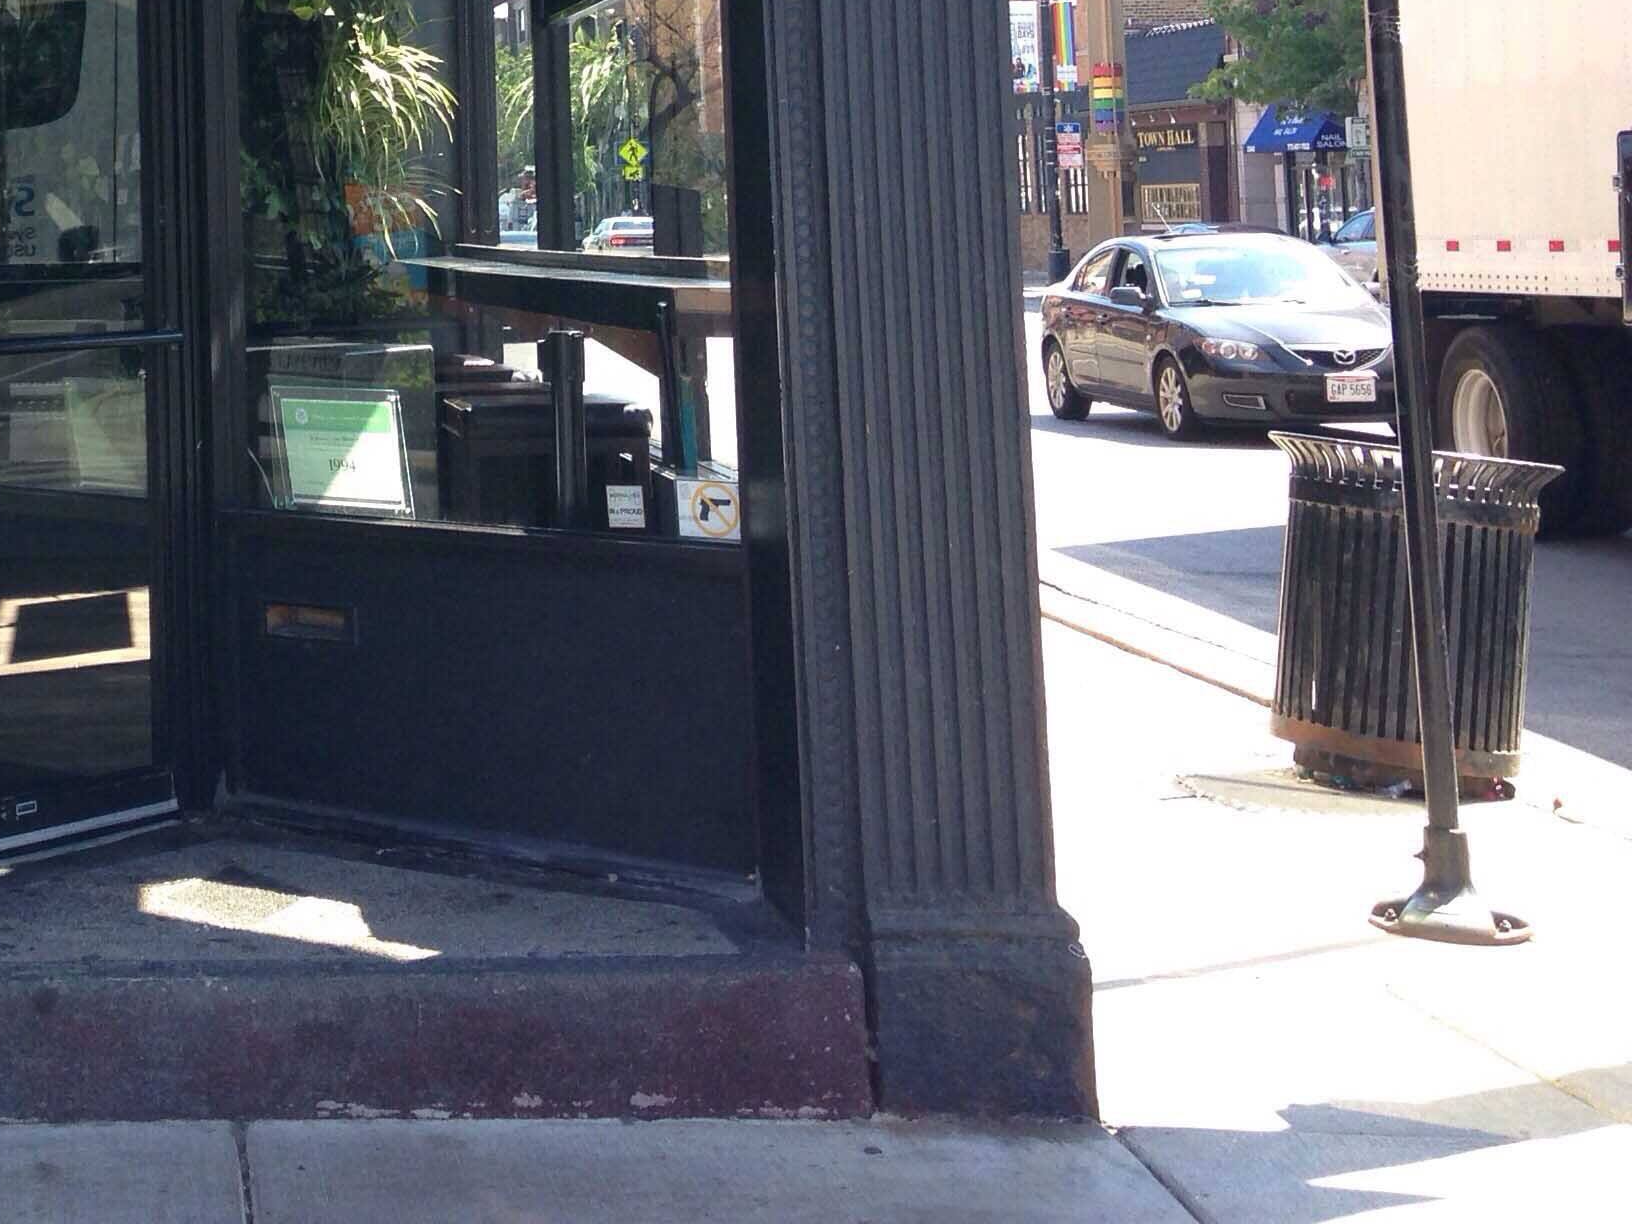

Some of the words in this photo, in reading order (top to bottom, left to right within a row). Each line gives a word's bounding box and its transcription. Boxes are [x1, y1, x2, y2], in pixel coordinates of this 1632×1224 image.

[1136, 130, 1166, 149] TOWN
[1166, 128, 1195, 146] HALL
[328, 458, 357, 473] 1994
